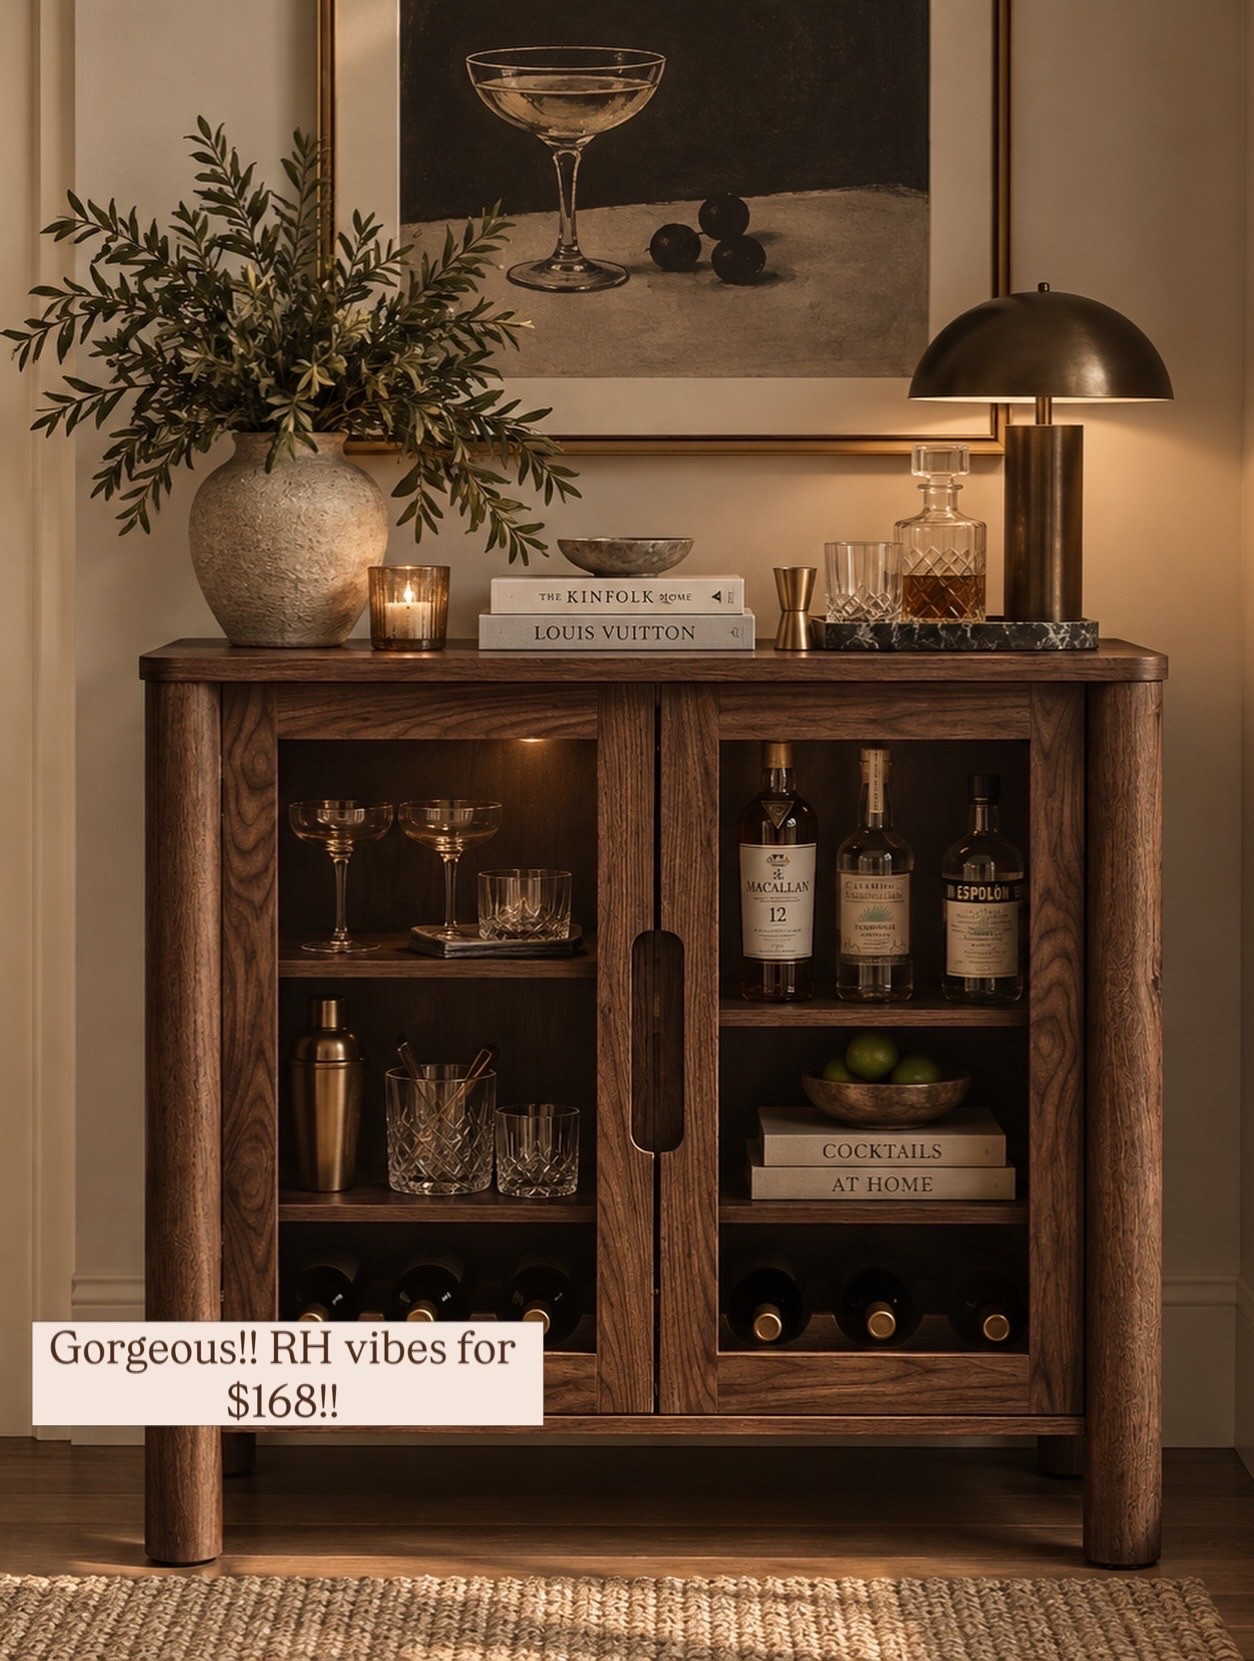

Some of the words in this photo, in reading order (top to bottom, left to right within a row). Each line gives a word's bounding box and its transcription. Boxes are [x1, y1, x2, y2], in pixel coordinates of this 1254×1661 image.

[538, 592, 562, 602] THE
[567, 590, 654, 604] KINFOLK
[534, 625, 595, 641] LOUIS
[602, 625, 696, 641] VUITTON
[745, 880, 810, 893] MACALLAN
[769, 906, 787, 923] 12
[822, 1143, 942, 1159] COCKTAILS
[831, 1176, 860, 1192] AT
[867, 1176, 934, 1192] HOME
